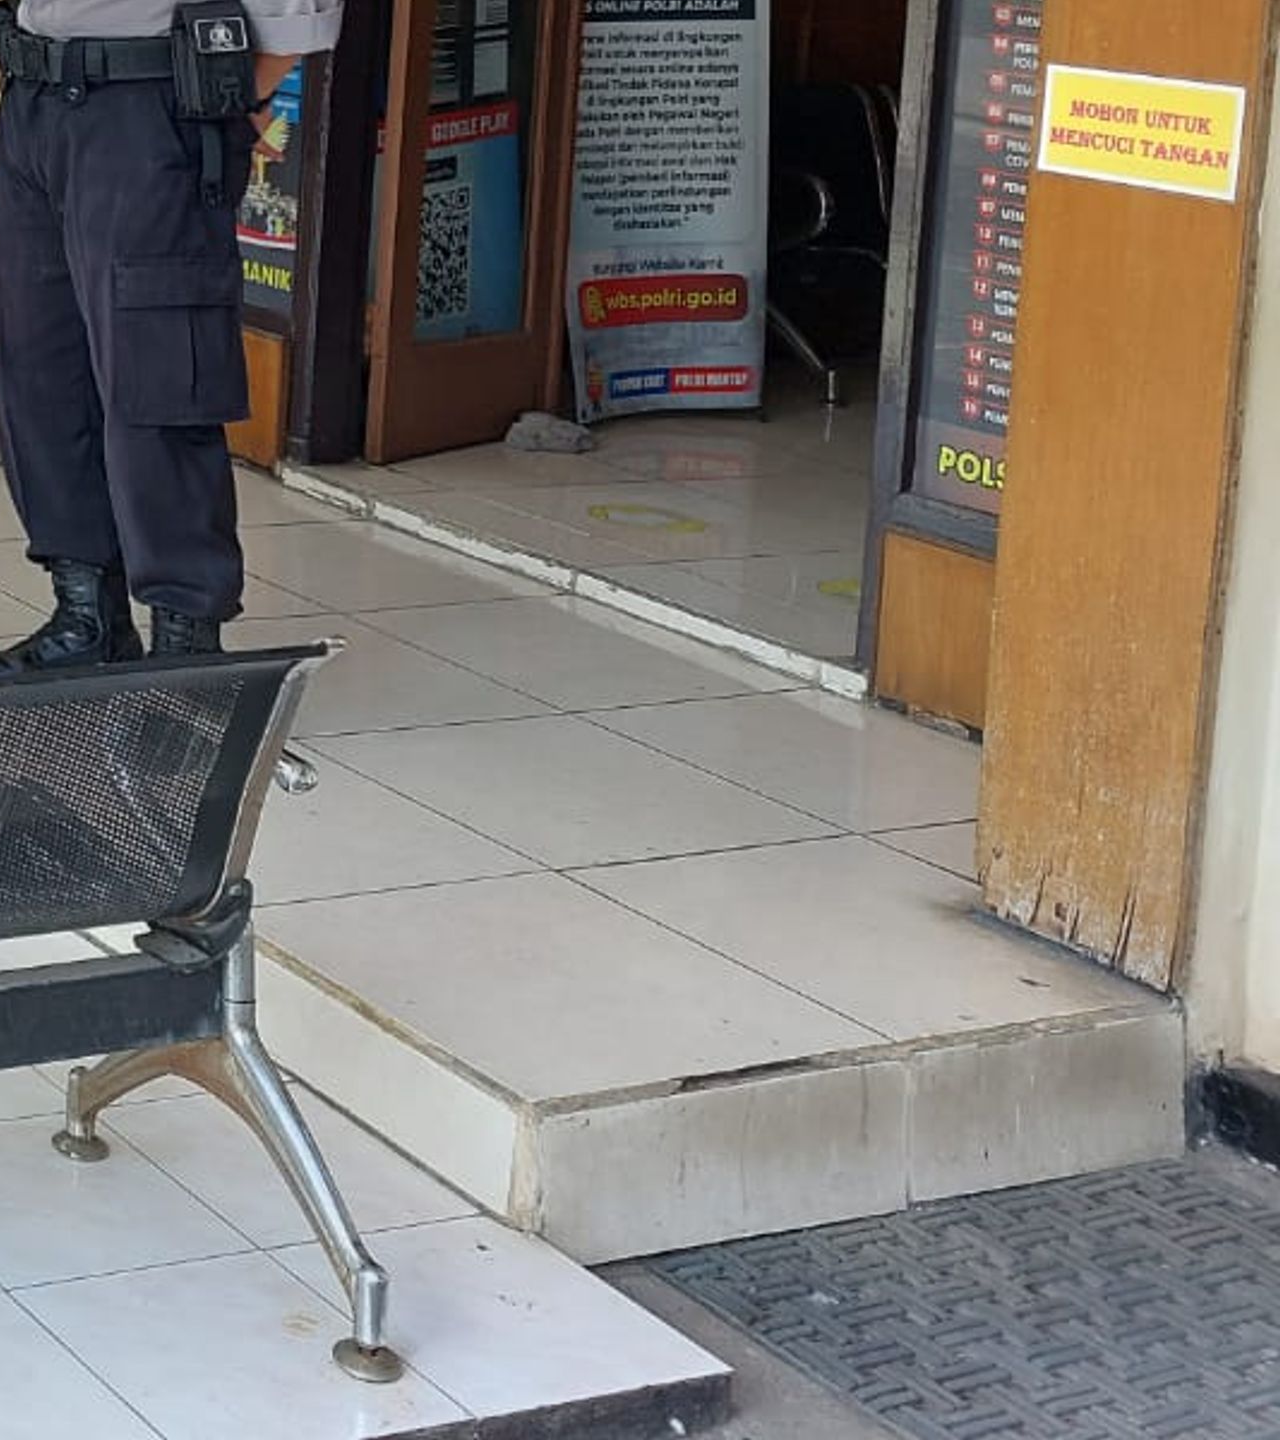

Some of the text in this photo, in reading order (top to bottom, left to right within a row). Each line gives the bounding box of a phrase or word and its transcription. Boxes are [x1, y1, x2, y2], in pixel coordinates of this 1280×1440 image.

[1069, 100, 1212, 136] MOHON UNTUK
[1050, 127, 1230, 169] MENCUCI TANGAN
[605, 288, 738, 314] wbs.polri.go.id
